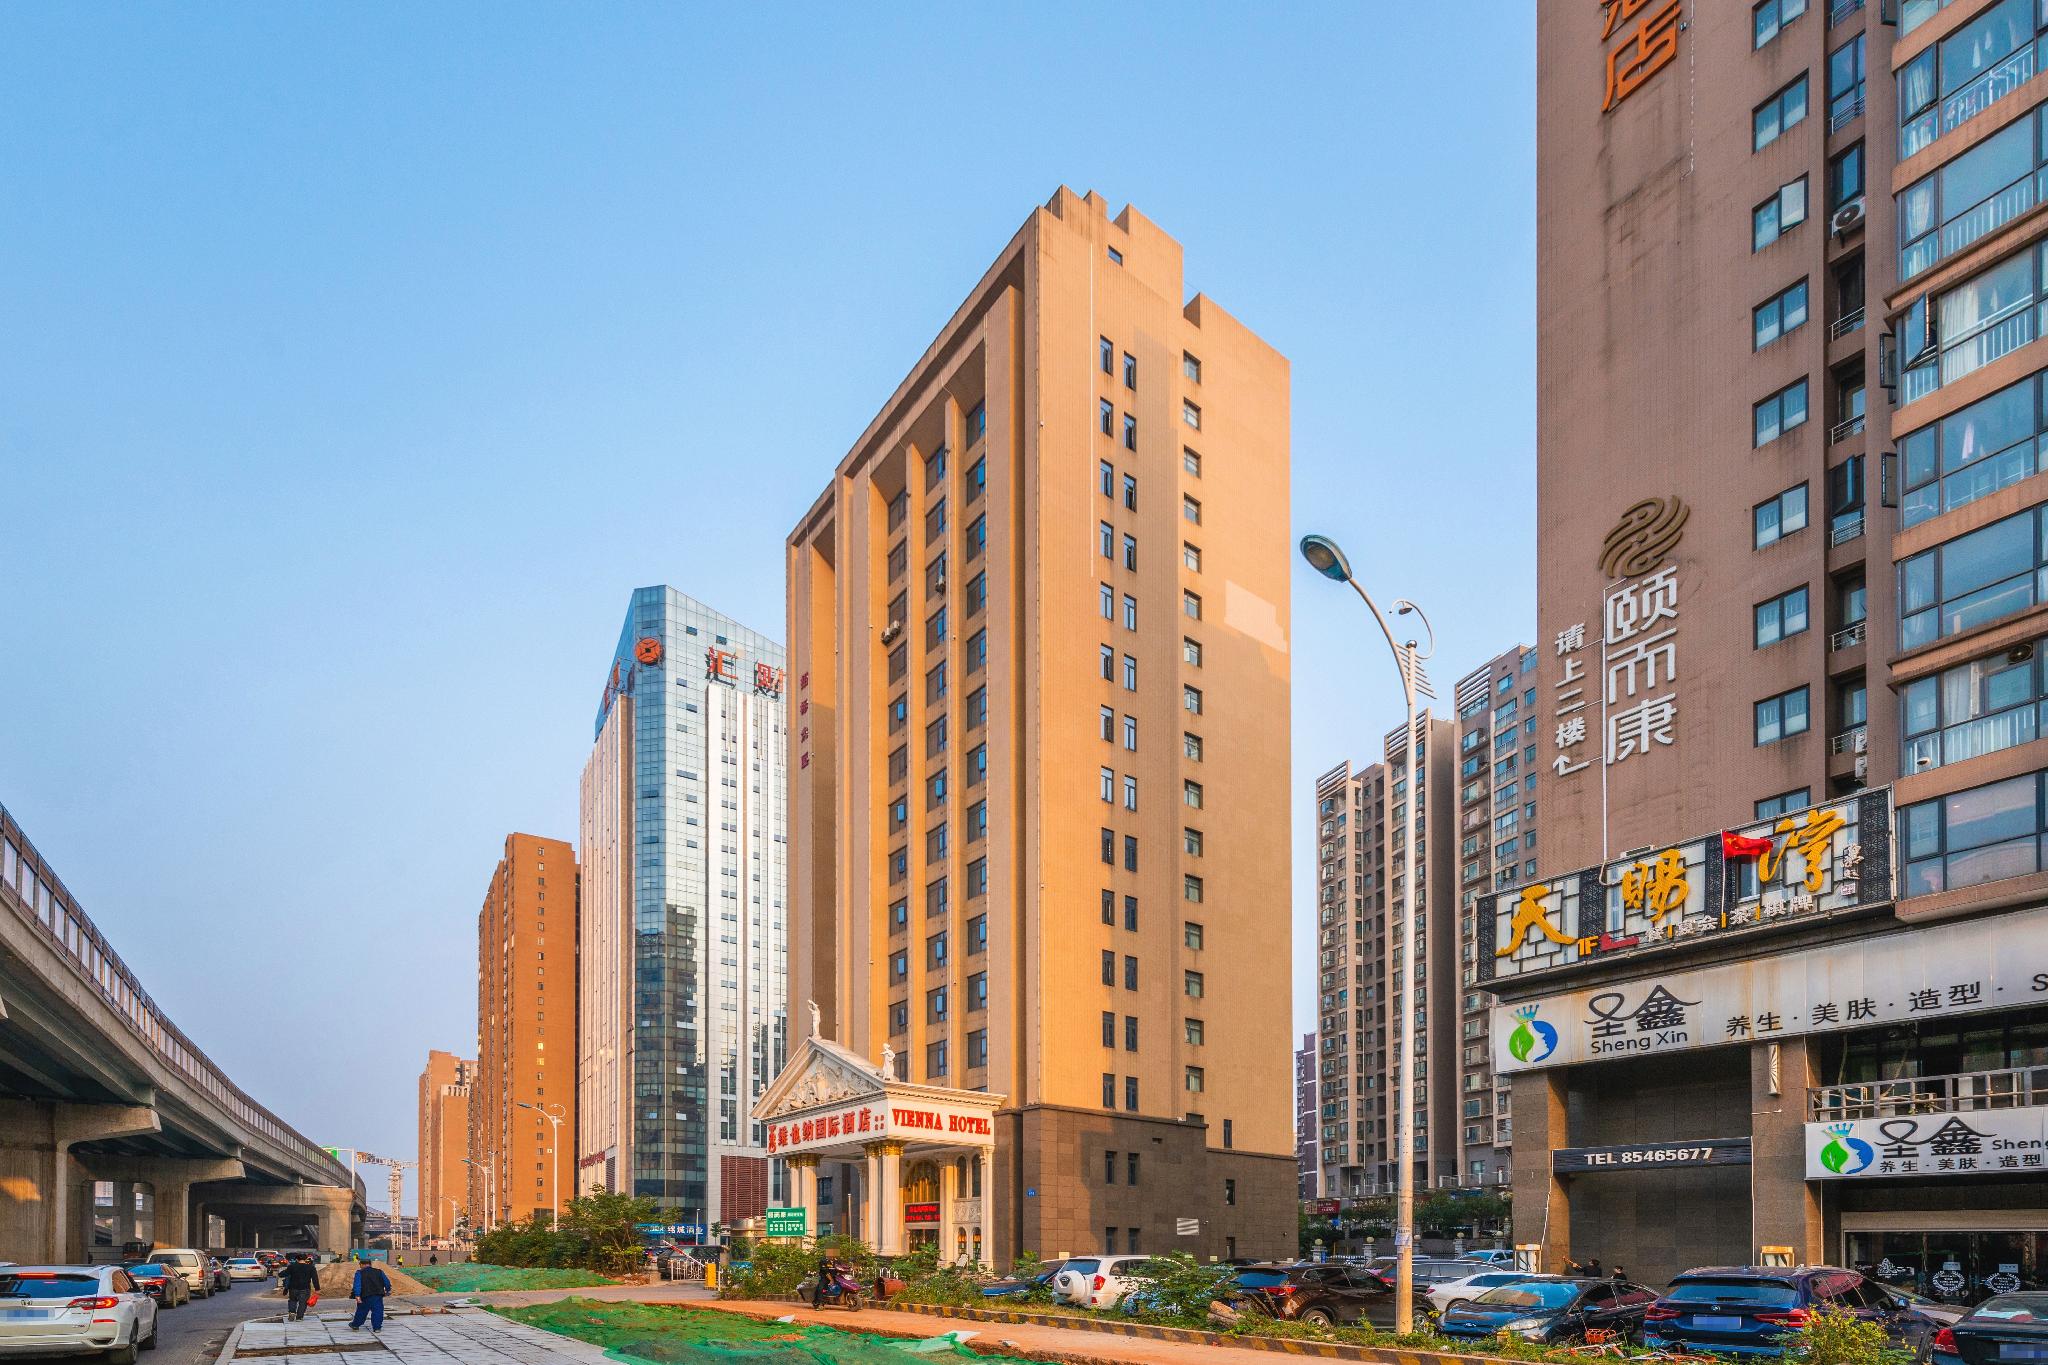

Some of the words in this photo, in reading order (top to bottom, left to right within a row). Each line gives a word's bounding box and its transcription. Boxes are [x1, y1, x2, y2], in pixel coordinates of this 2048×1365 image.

[1606, 565, 1679, 765] 颐而康
[1555, 622, 1587, 750] 请上二楼
[1591, 1037, 1651, 1054] Sheng
[1655, 1030, 1688, 1046] Xin
[892, 1109, 943, 1131] VIENNA
[949, 1115, 991, 1135] HOTEL
[1583, 1152, 1618, 1166] TEL
[1621, 1148, 1713, 1164] 85465677
